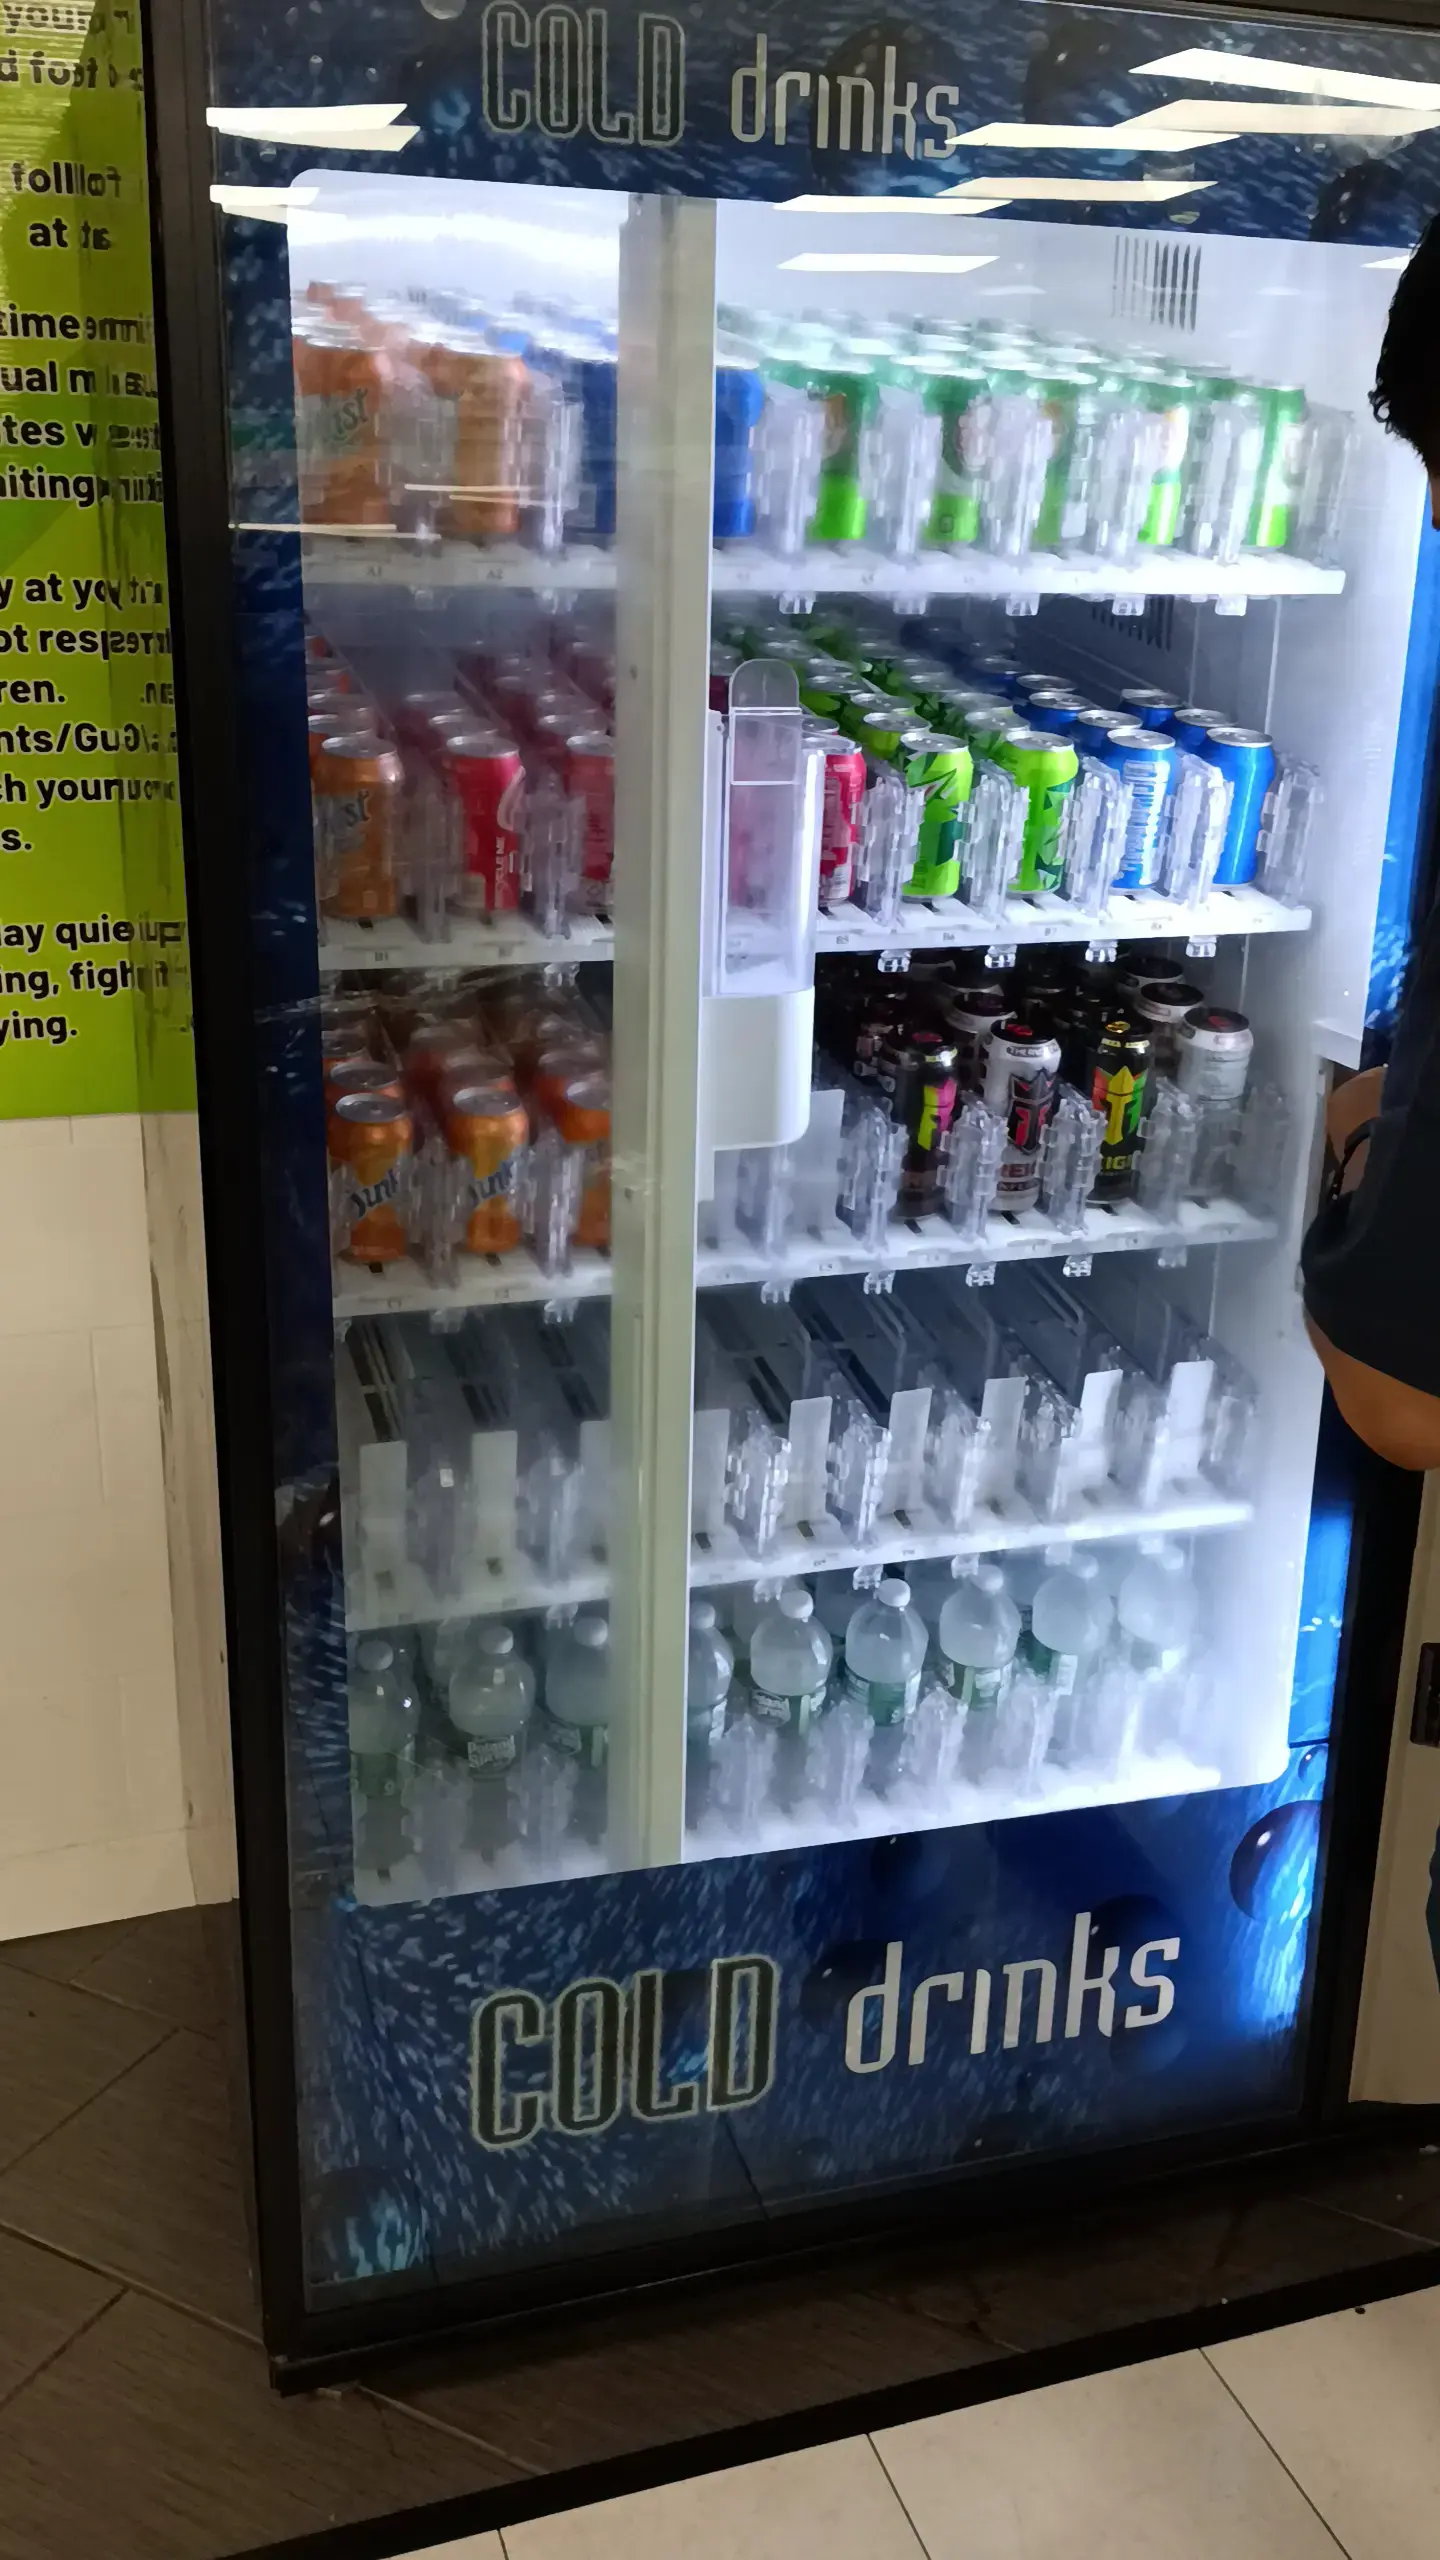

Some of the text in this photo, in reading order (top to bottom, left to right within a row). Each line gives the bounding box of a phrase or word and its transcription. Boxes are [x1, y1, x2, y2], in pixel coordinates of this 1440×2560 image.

[482, 0, 960, 161] COLD drinks
[29, 217, 69, 248] at
[25, 573, 64, 602] at
[469, 1910, 1182, 2152] COLD drinks
